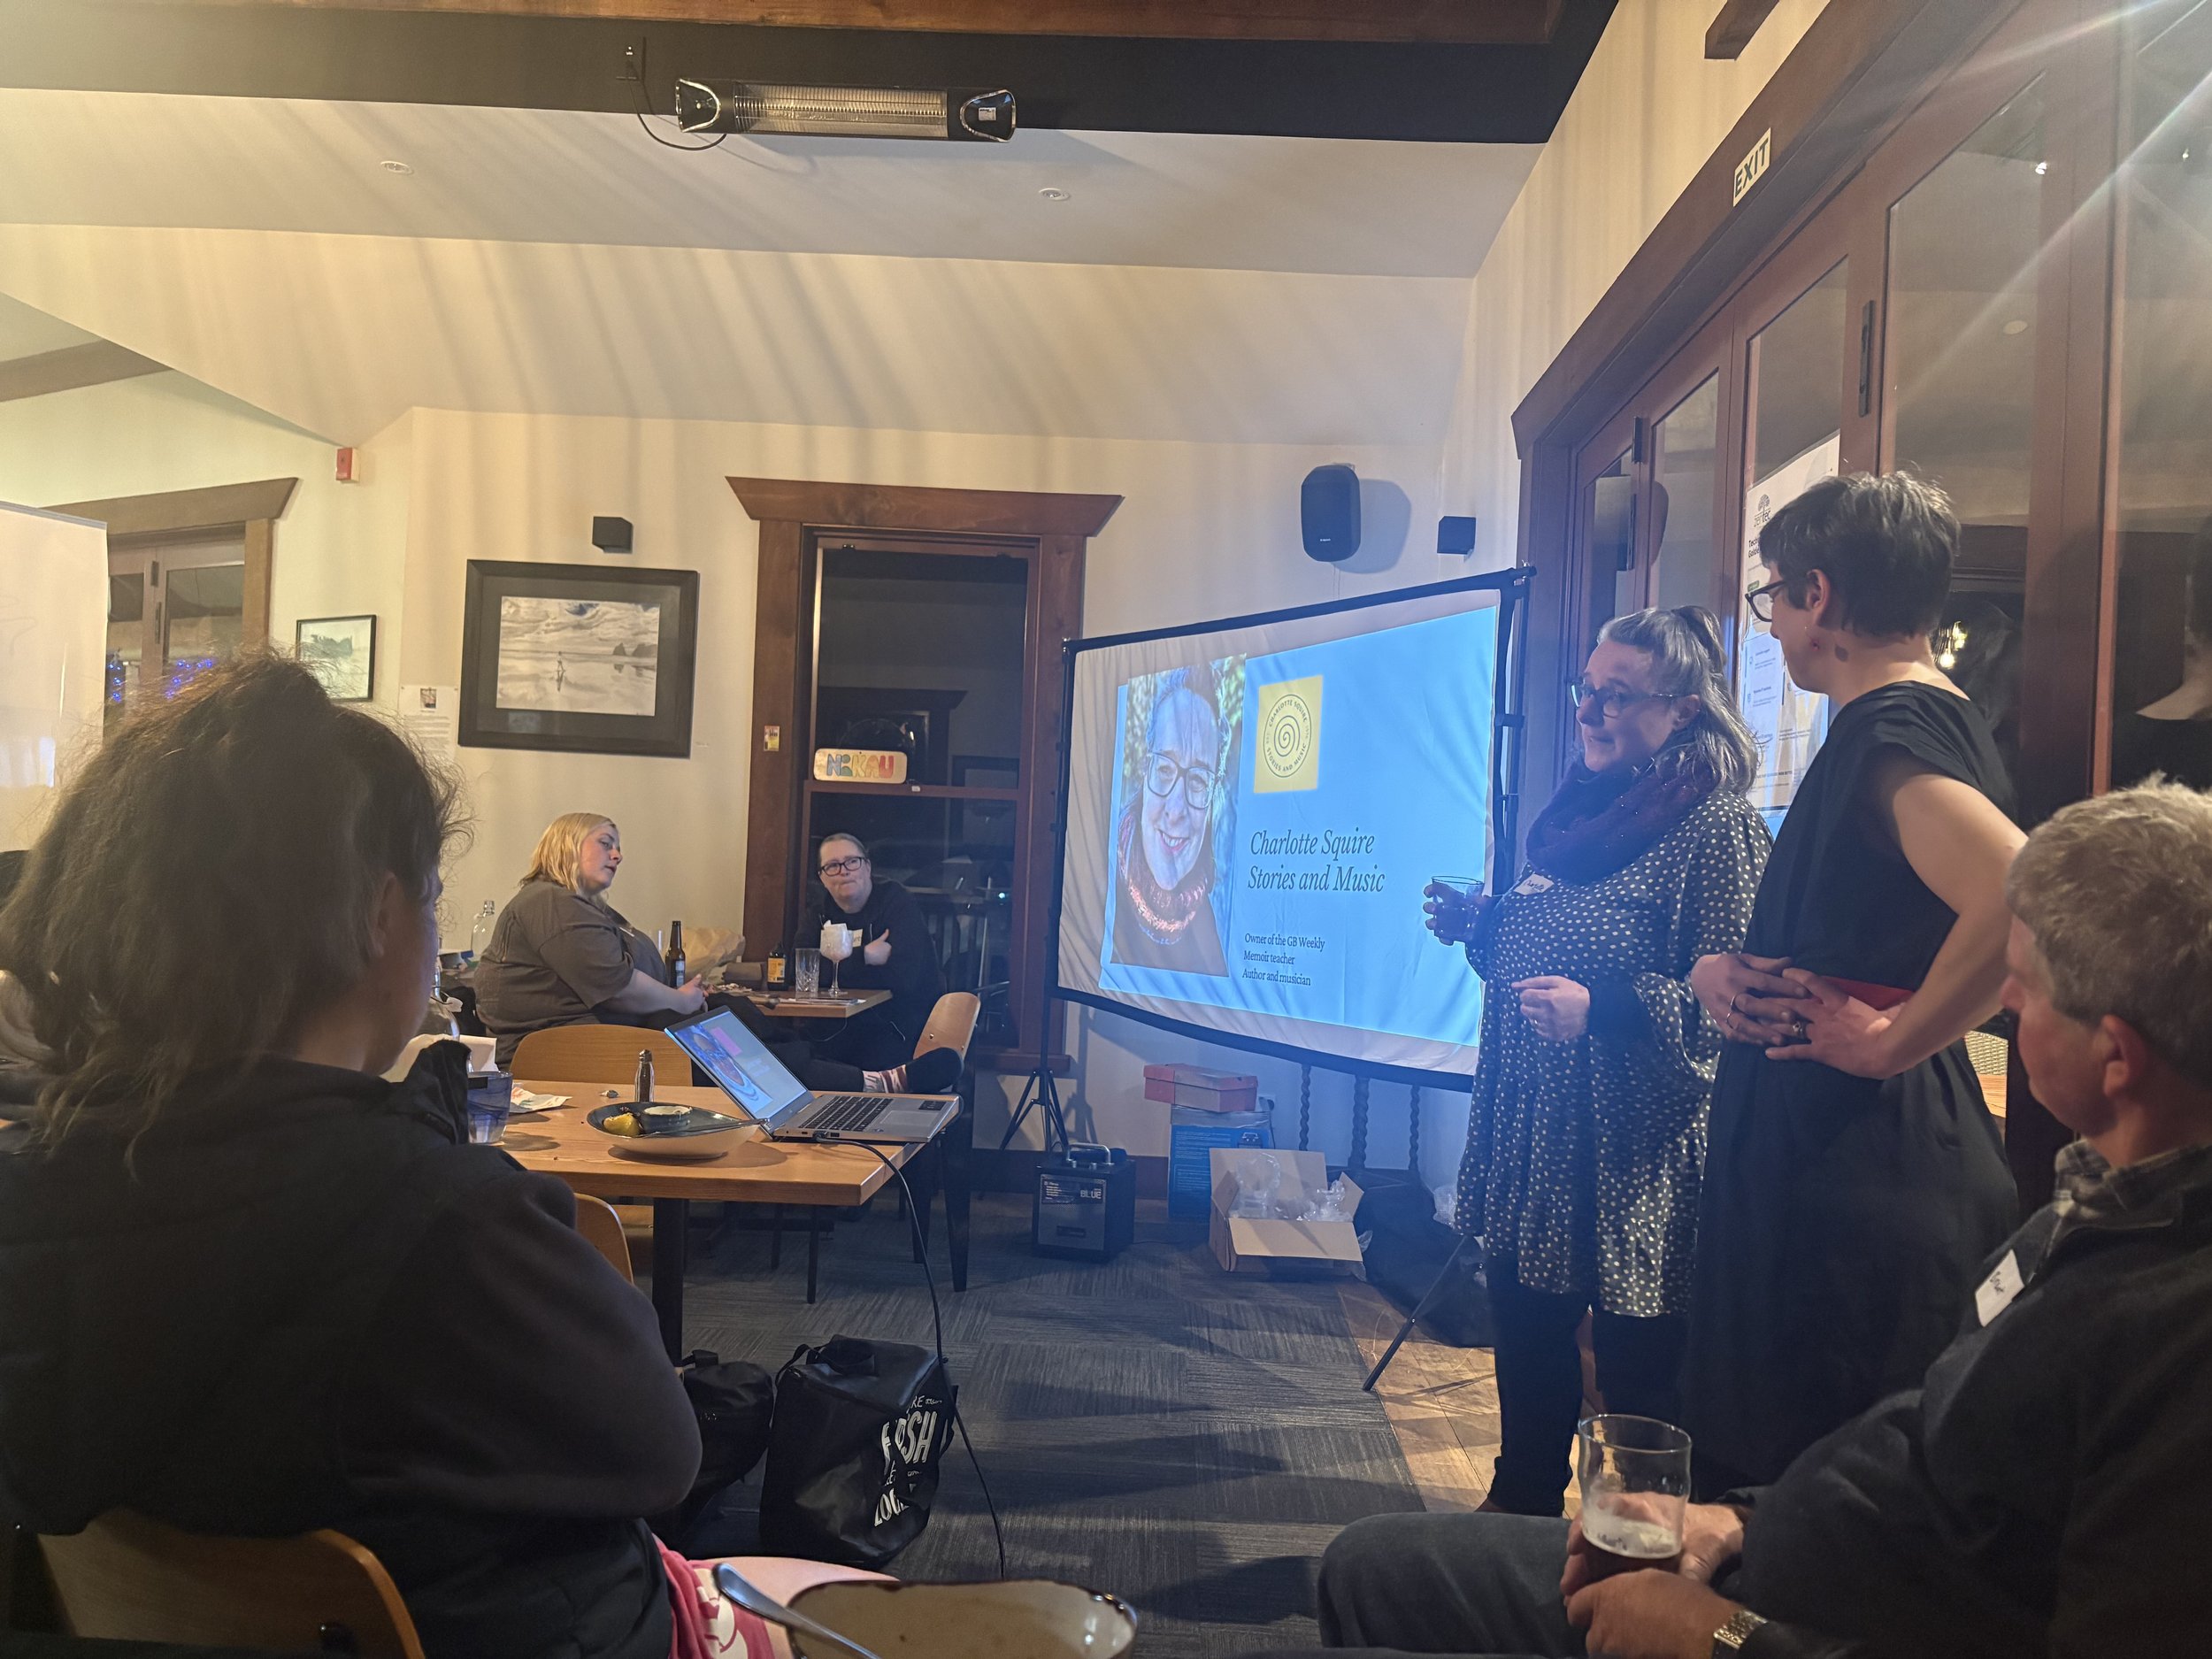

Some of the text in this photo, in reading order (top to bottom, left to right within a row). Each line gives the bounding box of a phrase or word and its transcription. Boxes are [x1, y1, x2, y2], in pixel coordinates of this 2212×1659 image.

[1735, 137, 1769, 198] EXIT
[1269, 699, 1293, 727] CHARLOTTE
[1266, 747, 1281, 772] STORIES
[1294, 743, 1306, 765] MUSIC
[1250, 826, 1375, 861] Charlotte Squire
[1248, 864, 1386, 893] Stories and Music
[1243, 949, 1295, 965] Memoir teacher
[1244, 933, 1325, 953] Owner of the GB Weekly
[1241, 968, 1311, 986] Author and musician
[1080, 1189, 1102, 1200] BLUE
